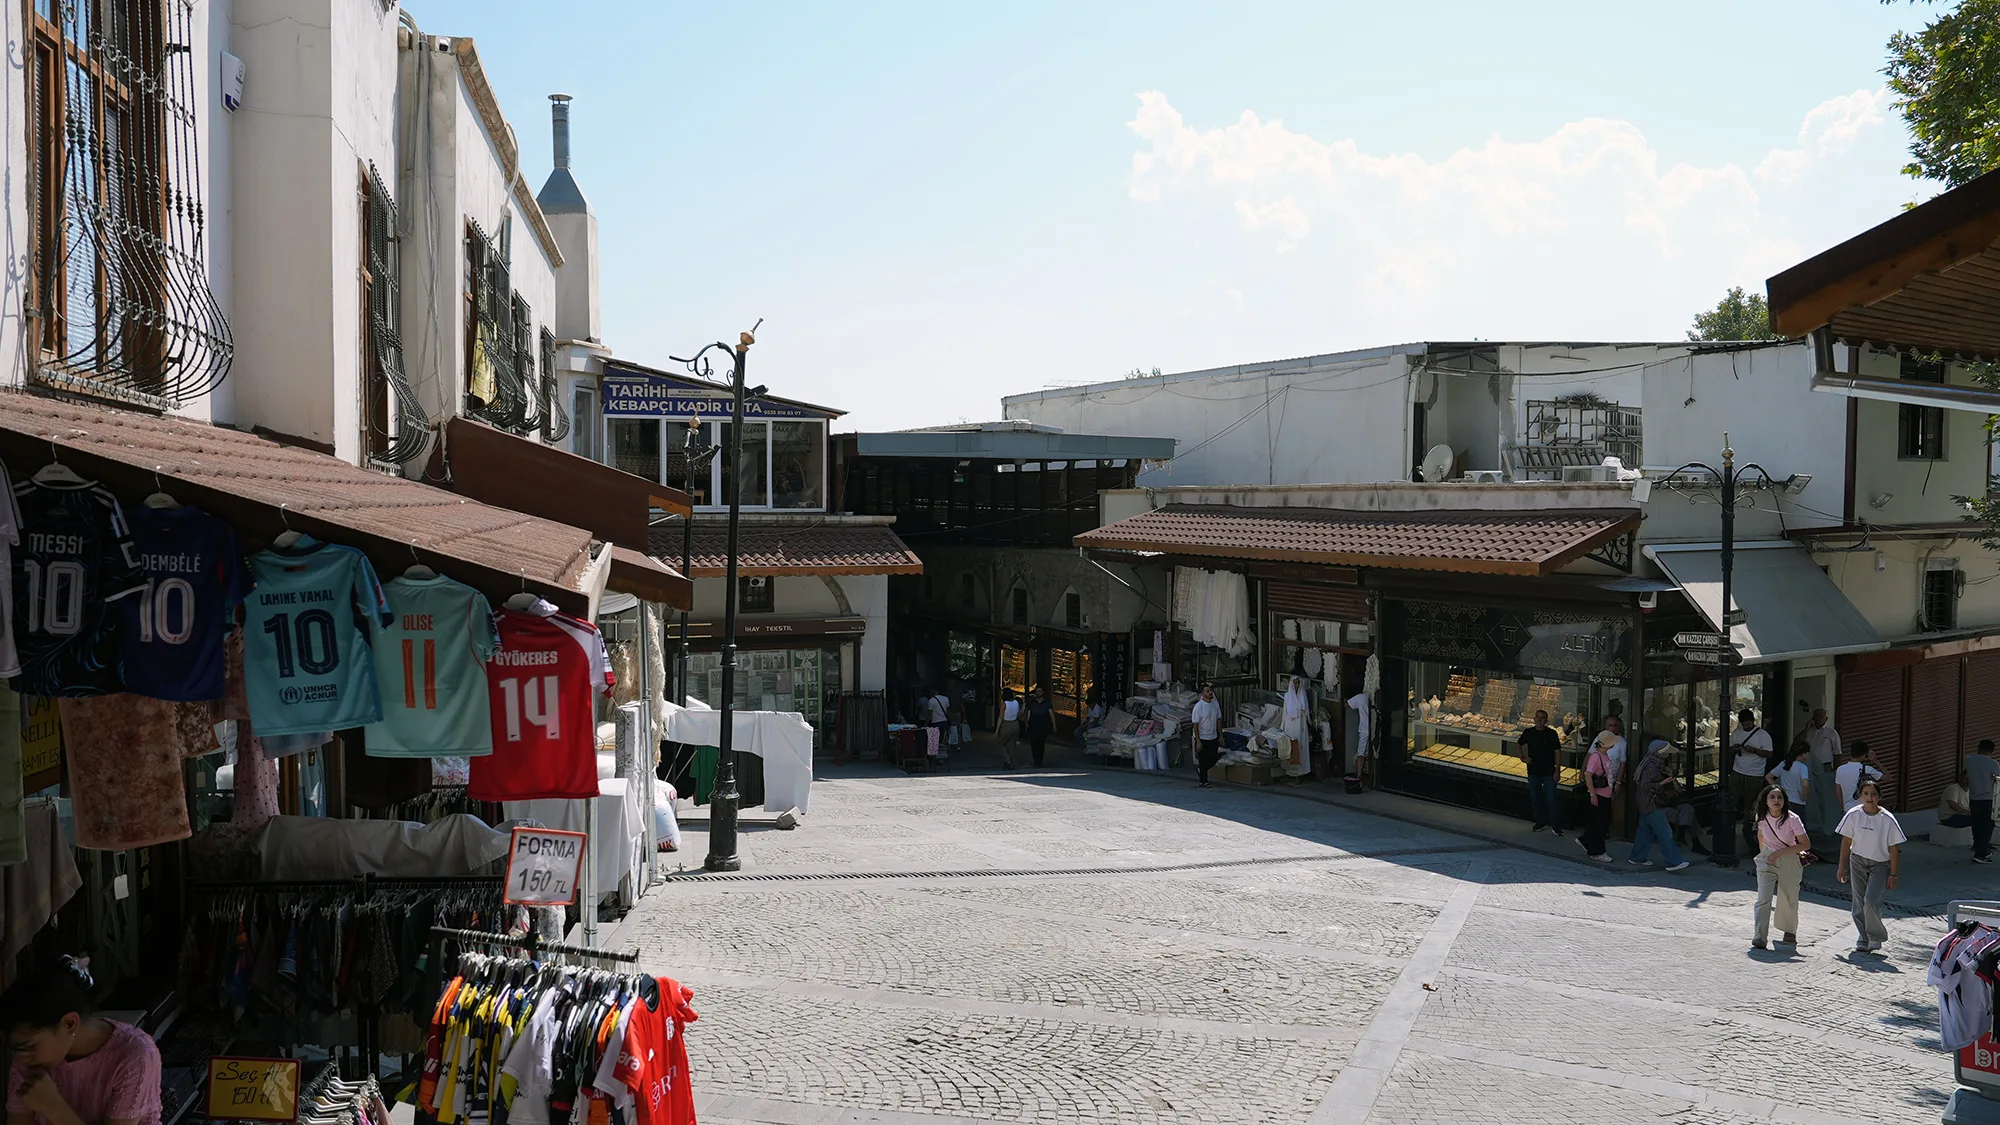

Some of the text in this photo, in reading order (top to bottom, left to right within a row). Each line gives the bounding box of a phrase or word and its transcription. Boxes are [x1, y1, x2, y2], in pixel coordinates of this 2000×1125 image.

[608, 383, 667, 398] TARİHİ
[609, 399, 762, 415] KEBAPÇI KADİR UTA
[29, 532, 84, 555] MESSI
[141, 552, 201, 573] DEMBÉLÉ
[24, 559, 86, 635] 10
[260, 589, 334, 606] LAMINE YAMAL
[140, 577, 195, 645] 10
[403, 614, 433, 631] OLISE
[263, 609, 340, 678] 10
[1561, 633, 1607, 655] ALTIN
[496, 650, 558, 666] GYÖKERES
[402, 639, 436, 709] 11
[303, 684, 337, 693] UNHCR
[304, 691, 338, 701] ACNUR
[499, 675, 561, 742] 14
[517, 835, 575, 859] FORMA
[519, 868, 568, 894] 150 TL
[215, 1061, 258, 1083] Seç
[232, 1086, 258, 1106] 150
